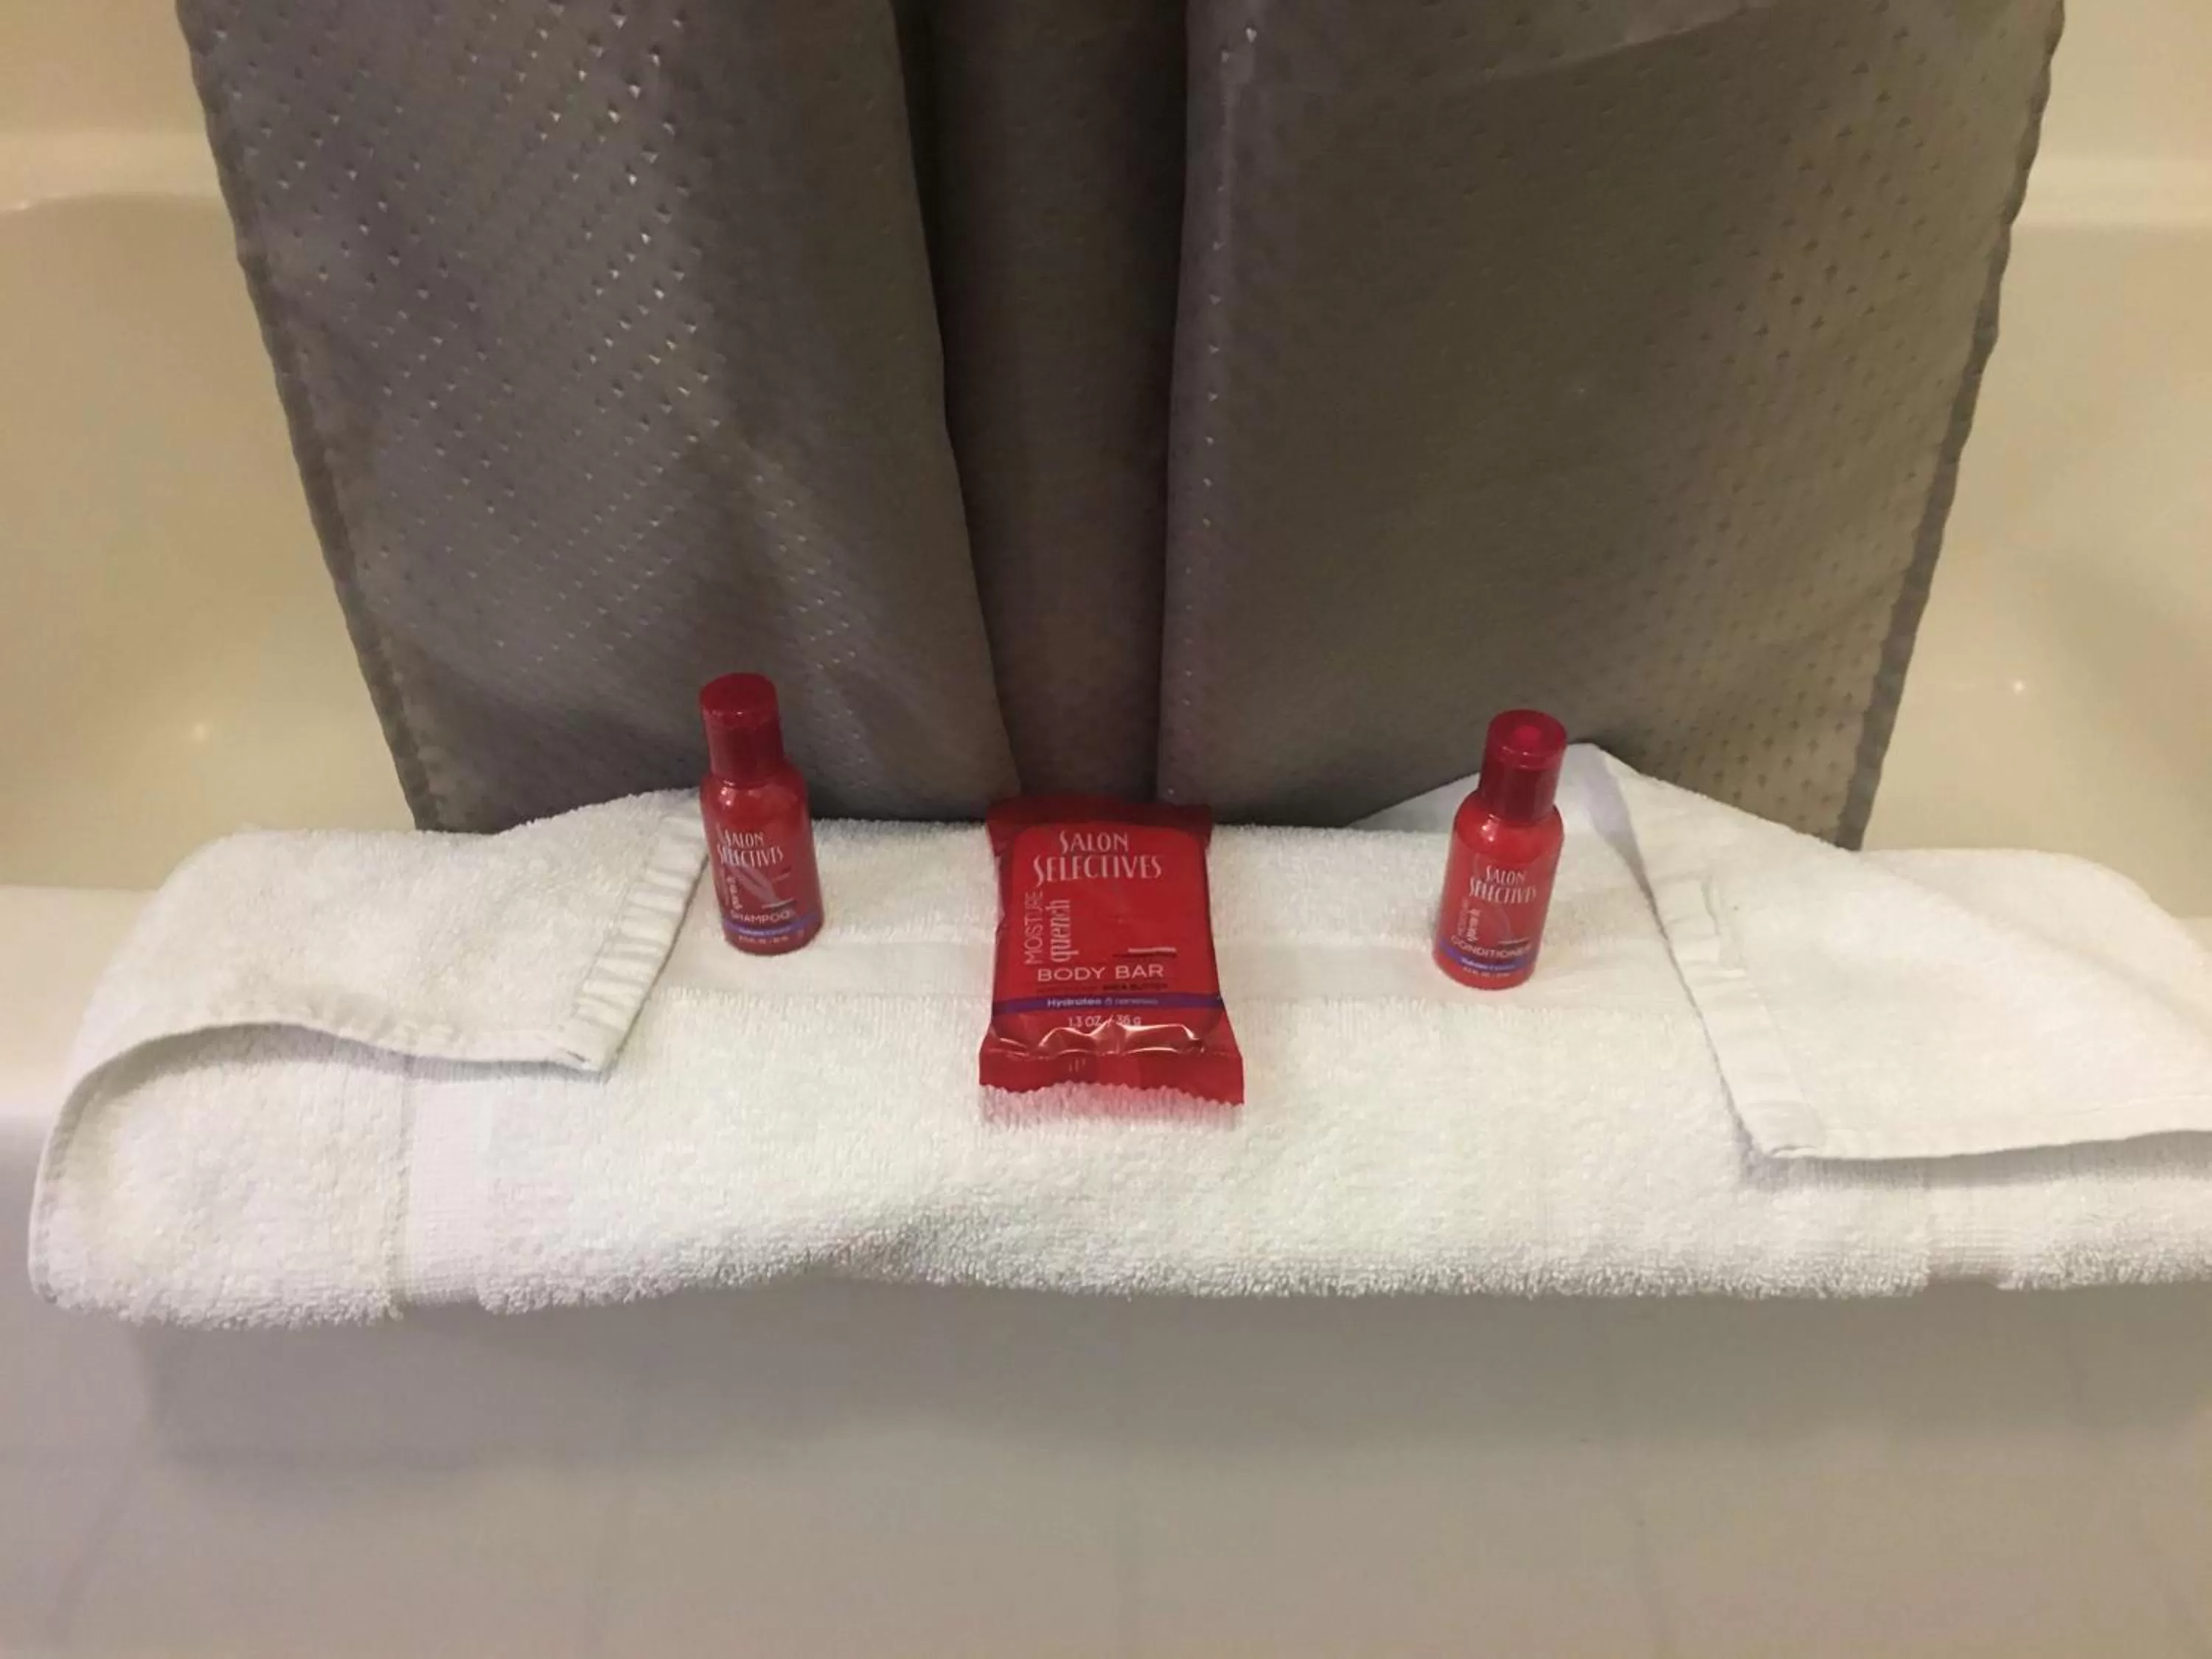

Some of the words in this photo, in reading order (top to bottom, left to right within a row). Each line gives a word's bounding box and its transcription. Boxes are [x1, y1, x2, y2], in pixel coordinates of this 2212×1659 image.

[725, 829, 765, 848] SALON
[1059, 830, 1130, 854] SALON
[1033, 855, 1163, 886] SELECTIVES
[1485, 865, 1528, 886] SALON
[1045, 899, 1079, 963] quench
[1037, 967, 1106, 982] BODY
[1115, 964, 1164, 980] BAR
